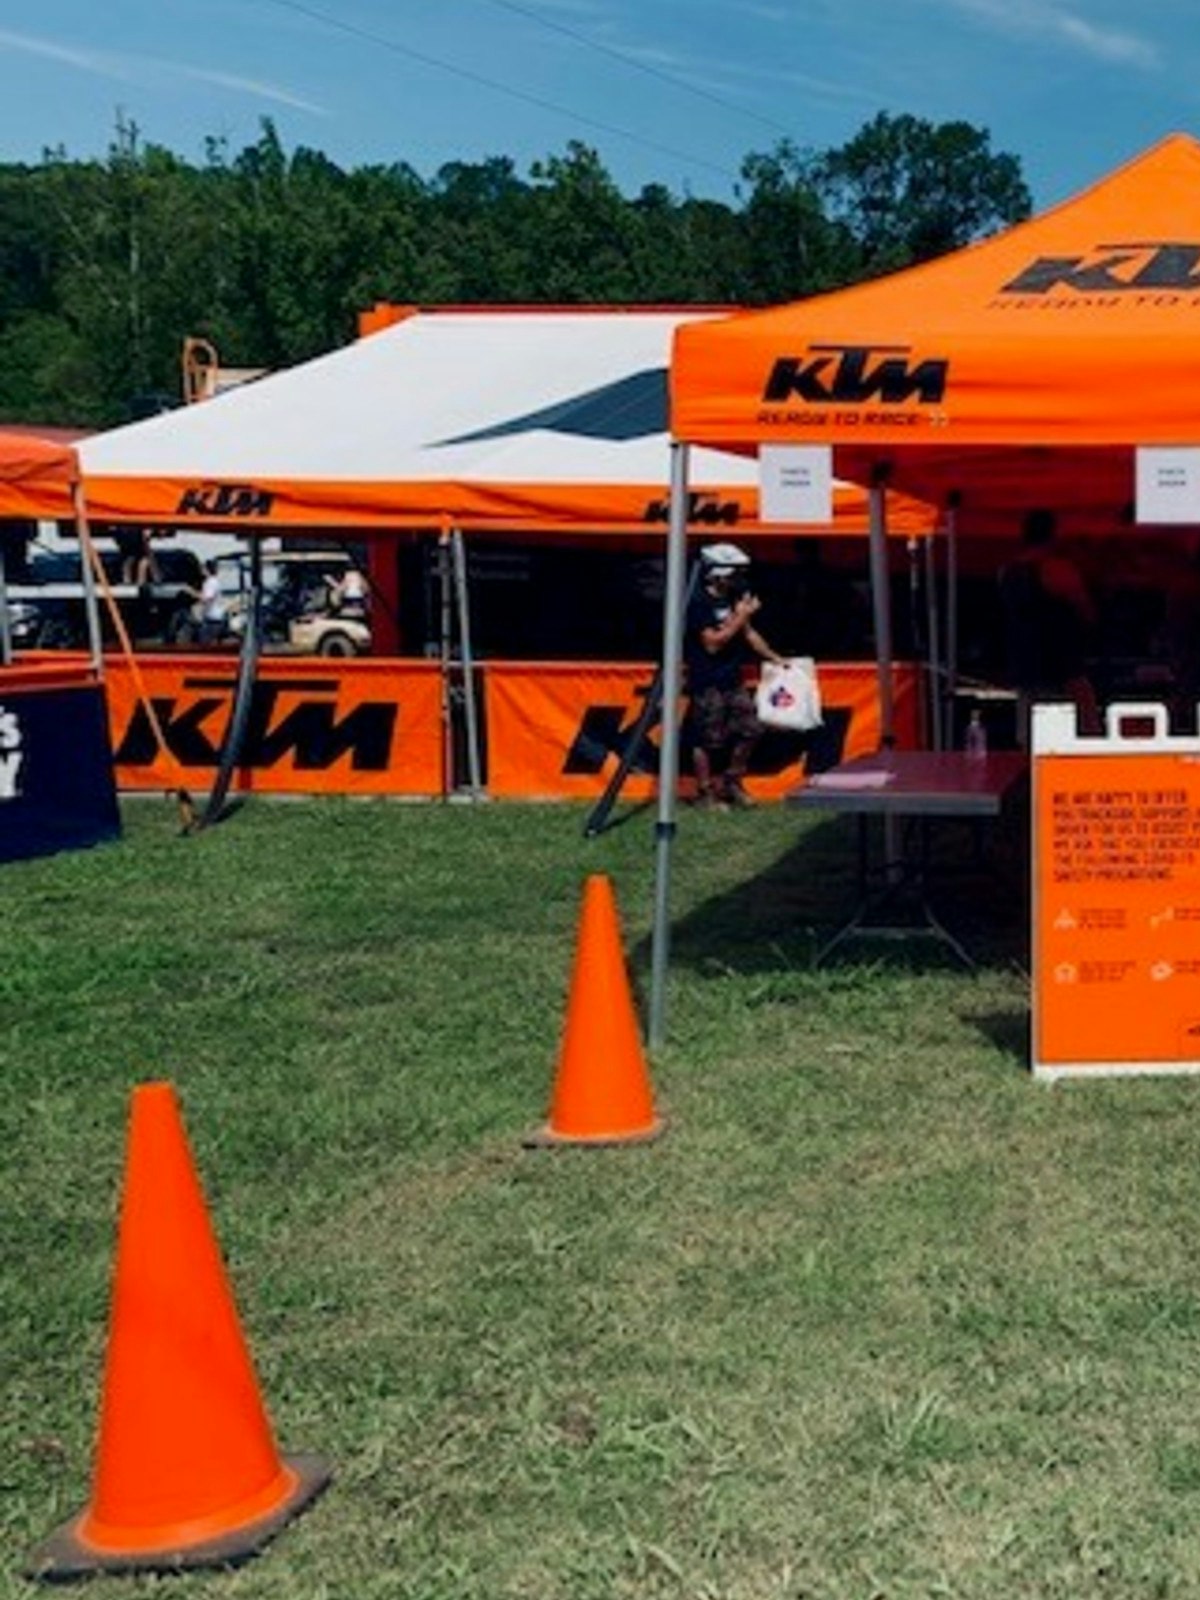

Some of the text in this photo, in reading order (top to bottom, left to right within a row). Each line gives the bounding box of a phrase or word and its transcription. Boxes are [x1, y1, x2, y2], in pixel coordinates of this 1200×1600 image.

[762, 345, 949, 403] KTM
[757, 412, 919, 425] READY TO RACE
[176, 481, 275, 515] KTM
[644, 491, 740, 525] KTM
[117, 679, 398, 772] KTM
[562, 685, 854, 775] KM
